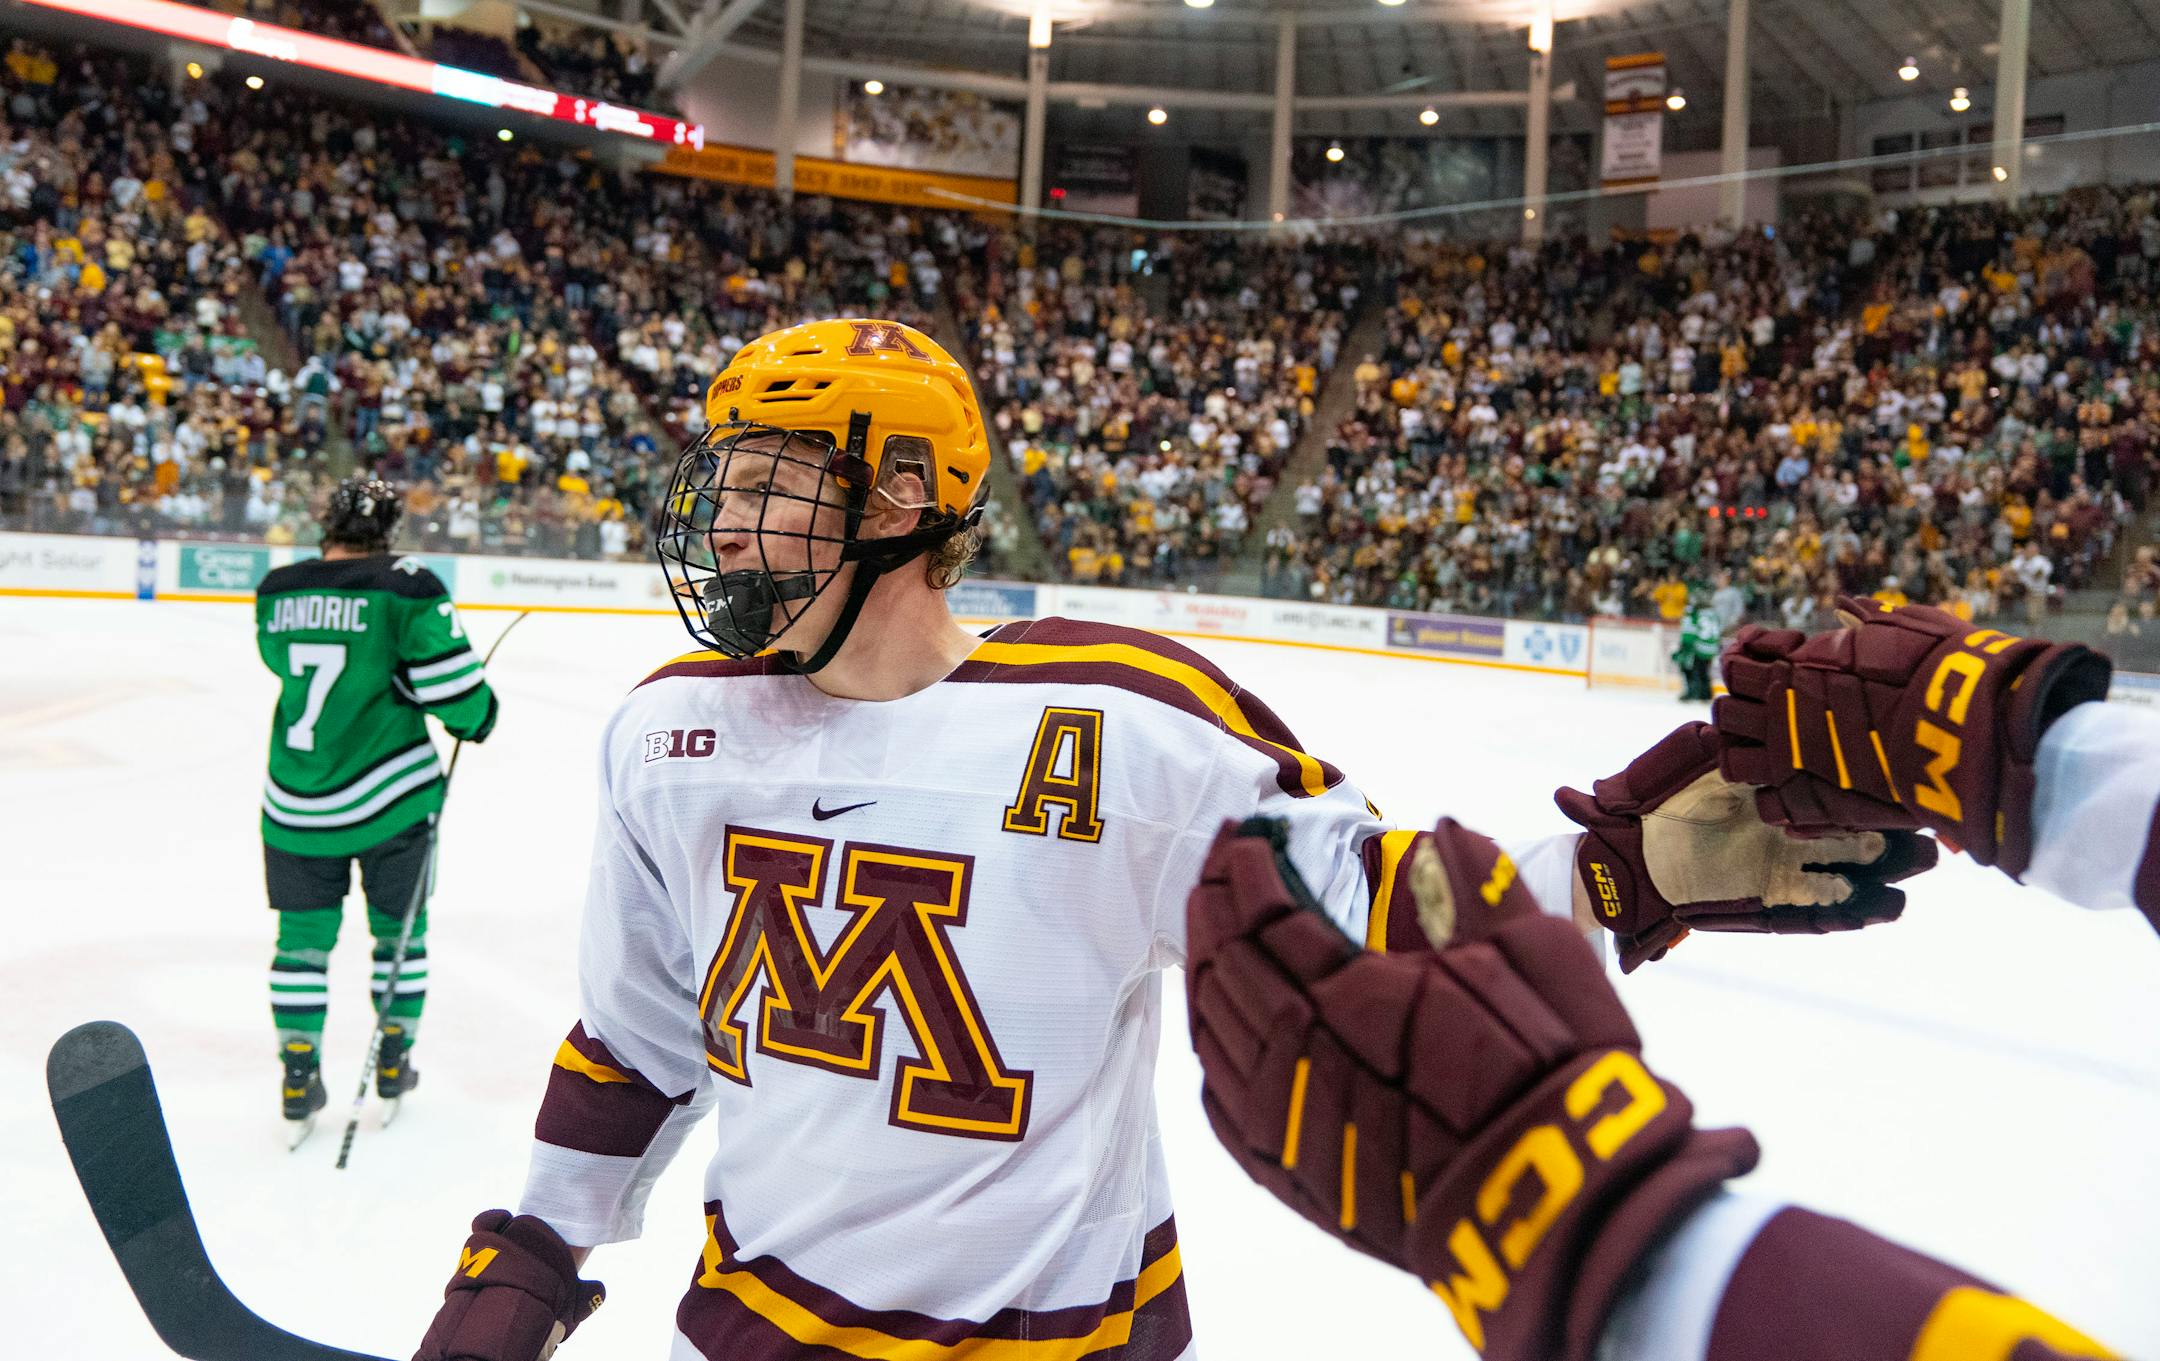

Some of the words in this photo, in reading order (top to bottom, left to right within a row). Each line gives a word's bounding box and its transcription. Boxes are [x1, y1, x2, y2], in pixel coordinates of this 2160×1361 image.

[267, 595, 368, 633] JANDRIC
[702, 596, 734, 613] CM
[286, 643, 346, 751] 7
[1915, 629, 2023, 822] CCM
[1002, 706, 1105, 843] A
[1590, 863, 1617, 918] CCM
[699, 824, 1034, 1142] M
[1431, 1050, 1667, 1352] CCM
